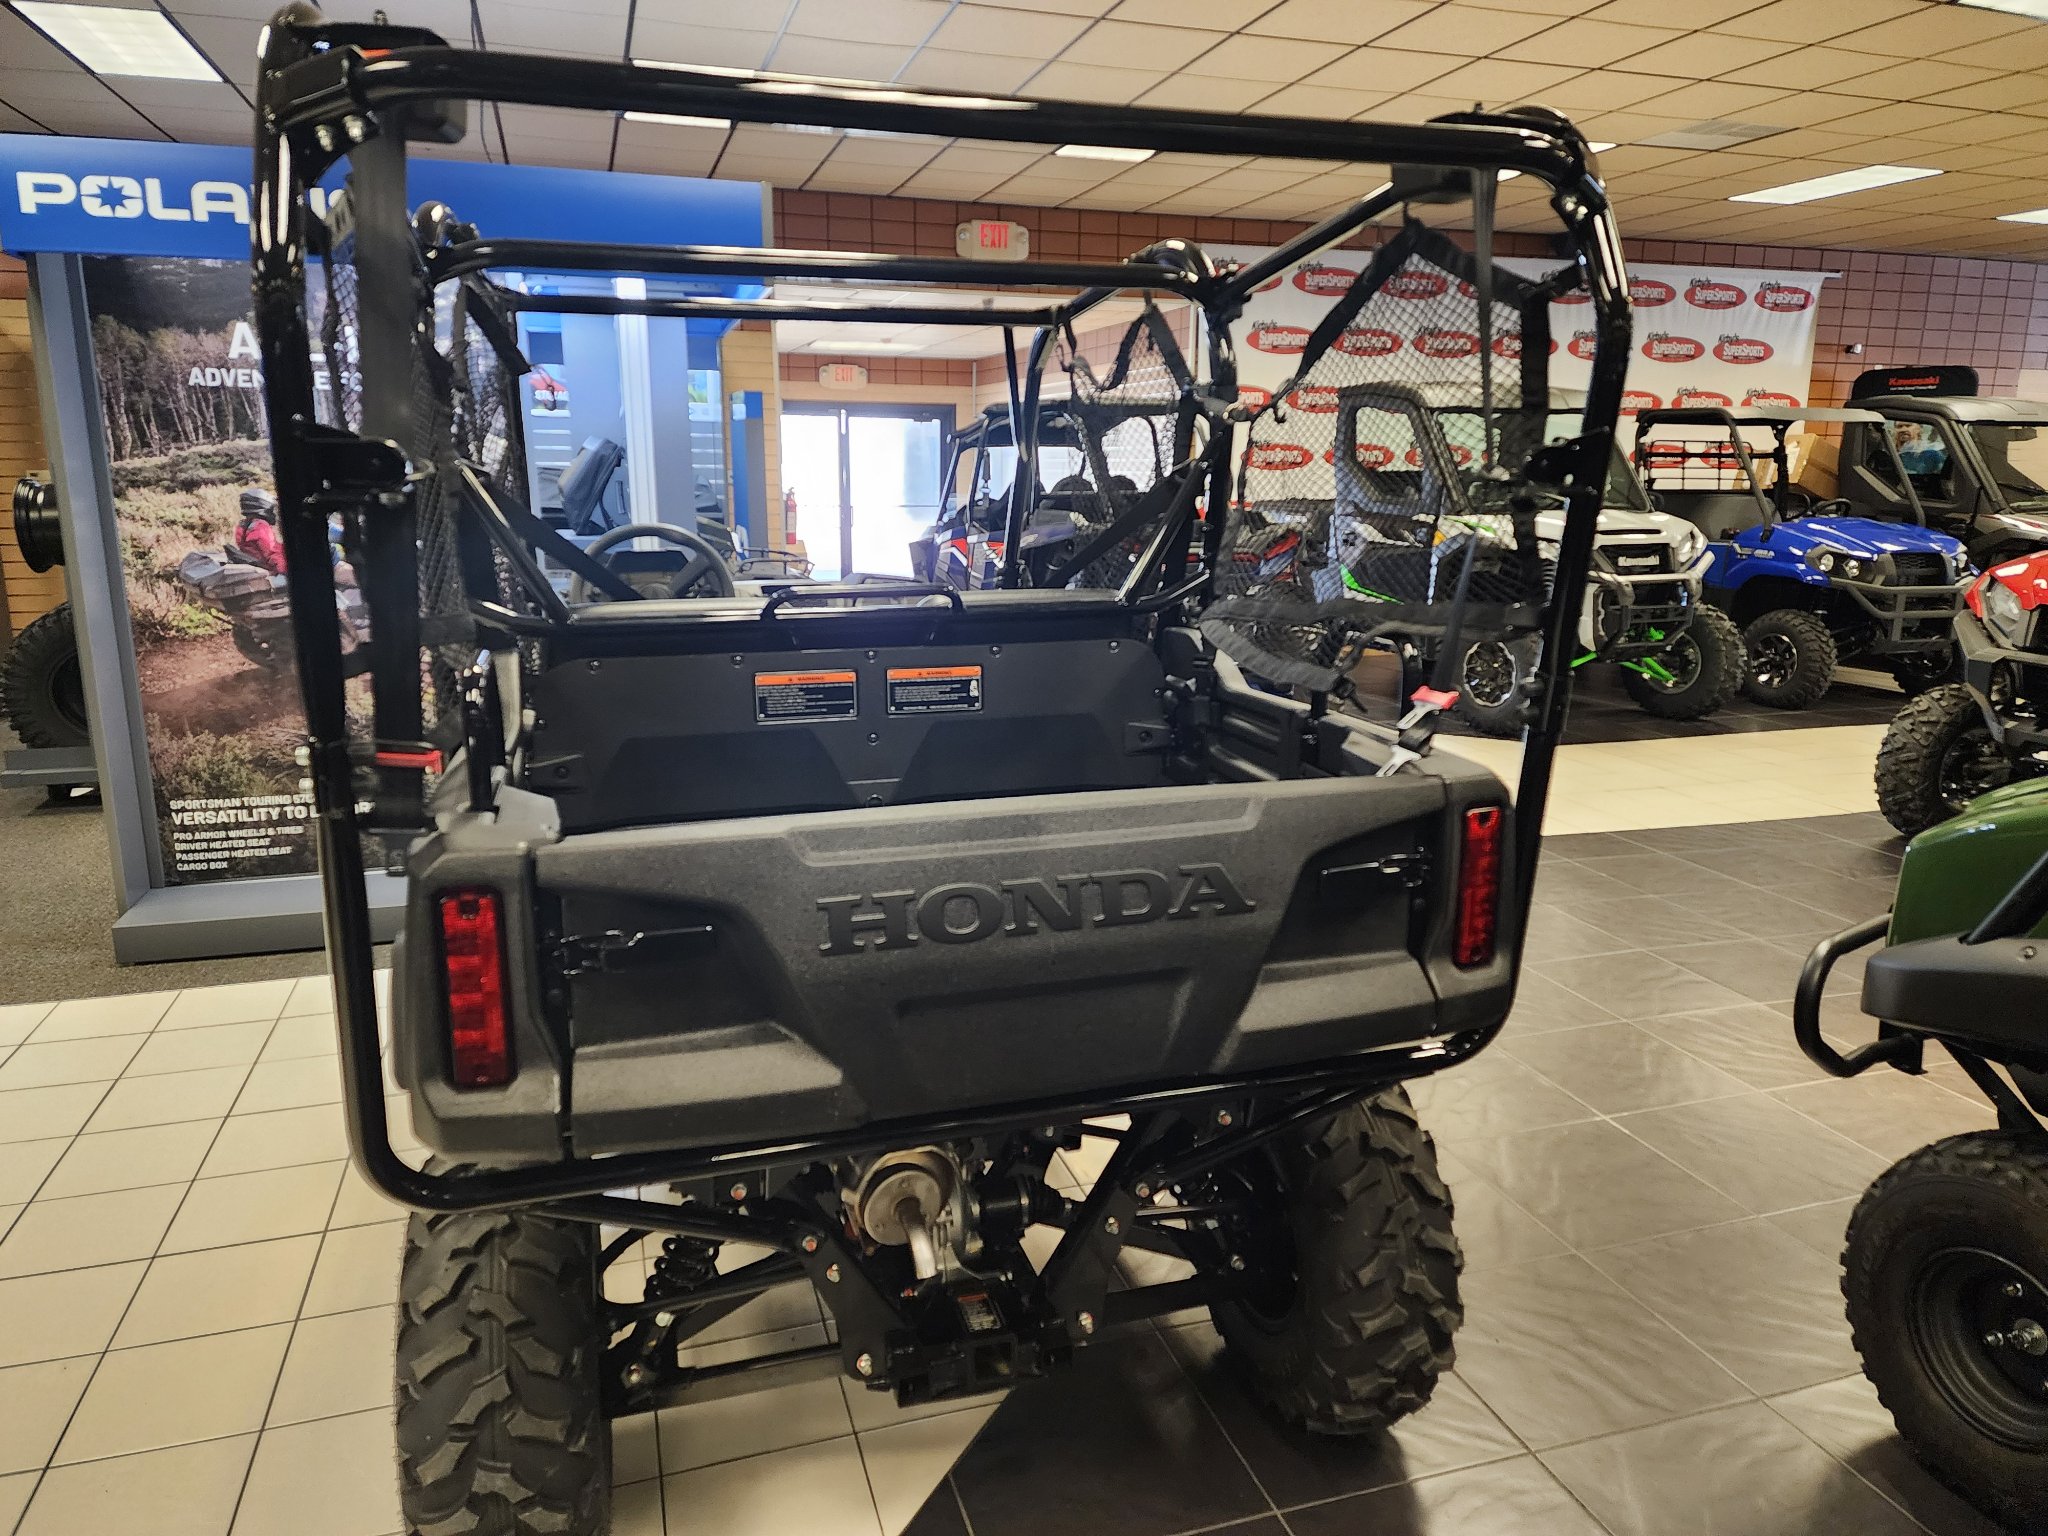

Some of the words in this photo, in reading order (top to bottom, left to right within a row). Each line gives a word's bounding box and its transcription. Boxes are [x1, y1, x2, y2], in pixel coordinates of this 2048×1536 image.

[16, 171, 346, 225] POLAI
[980, 223, 1009, 249] EXIT
[835, 367, 853, 382] EXIT
[170, 798, 242, 810] SPORTSMAN
[242, 795, 292, 807] TOURING
[171, 806, 281, 825] VERSATILITY
[283, 806, 308, 819] TO
[173, 832, 194, 841] PRO
[194, 830, 226, 840] ARMOR
[228, 828, 266, 838] WHEELS
[174, 841, 208, 851] DRIVER
[209, 839, 246, 849] HEATED
[247, 837, 272, 847] SEAT
[175, 850, 230, 860] PASSENGER
[231, 848, 267, 858] HEATED
[268, 846, 292, 856] SEAT
[176, 862, 208, 871] CARGO
[210, 861, 228, 870] BOX
[816, 862, 1256, 957] HONDA
